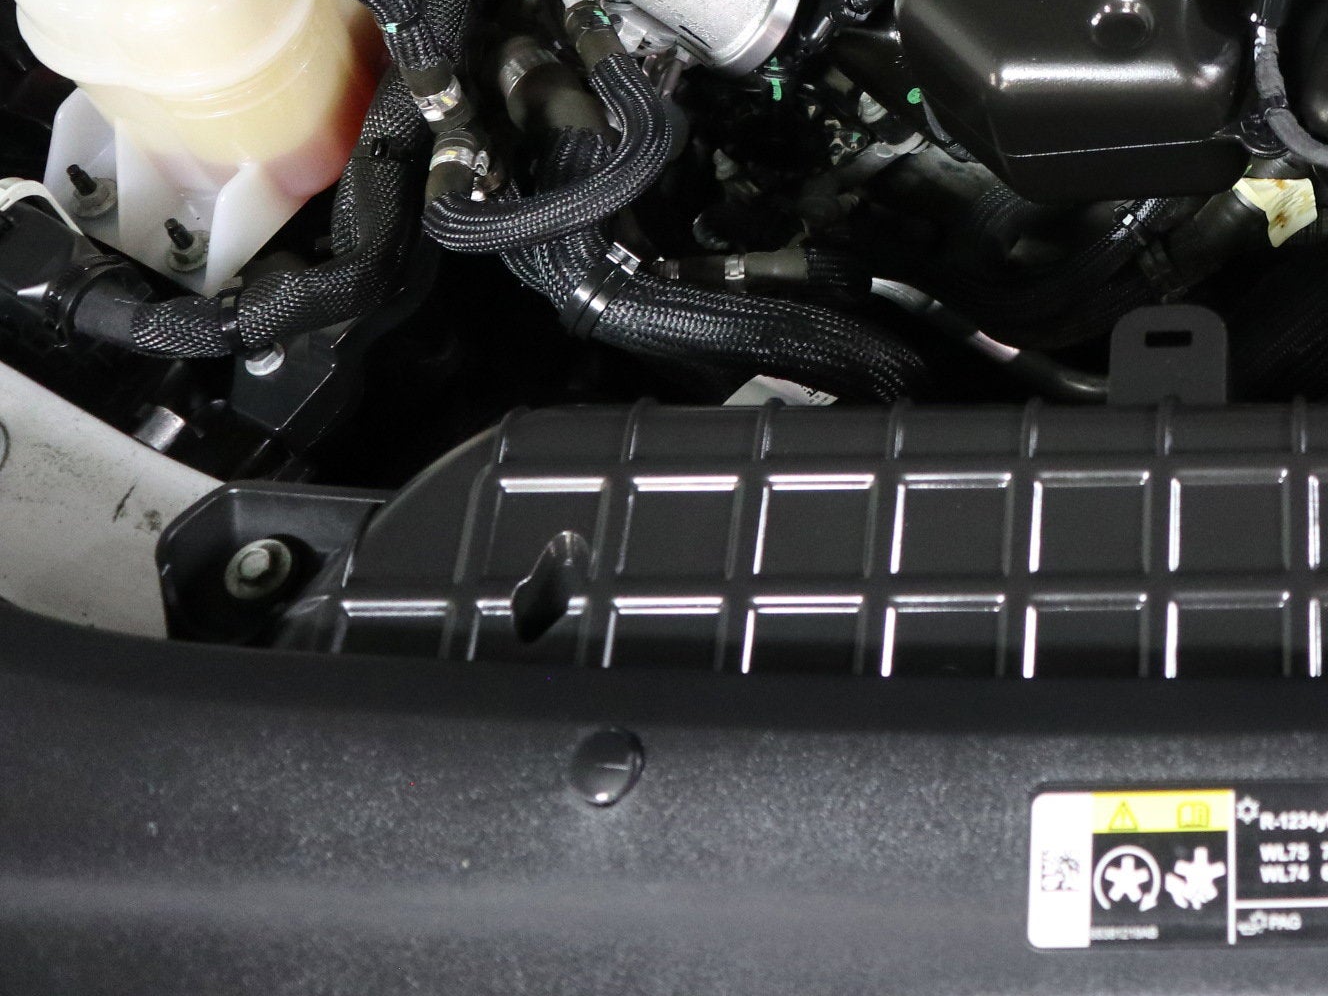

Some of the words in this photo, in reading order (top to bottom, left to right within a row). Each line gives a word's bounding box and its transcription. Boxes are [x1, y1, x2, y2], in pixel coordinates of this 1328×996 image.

[1259, 841, 1311, 862] WL75
[1259, 863, 1311, 884] WL74
[1268, 914, 1303, 932] PAG
